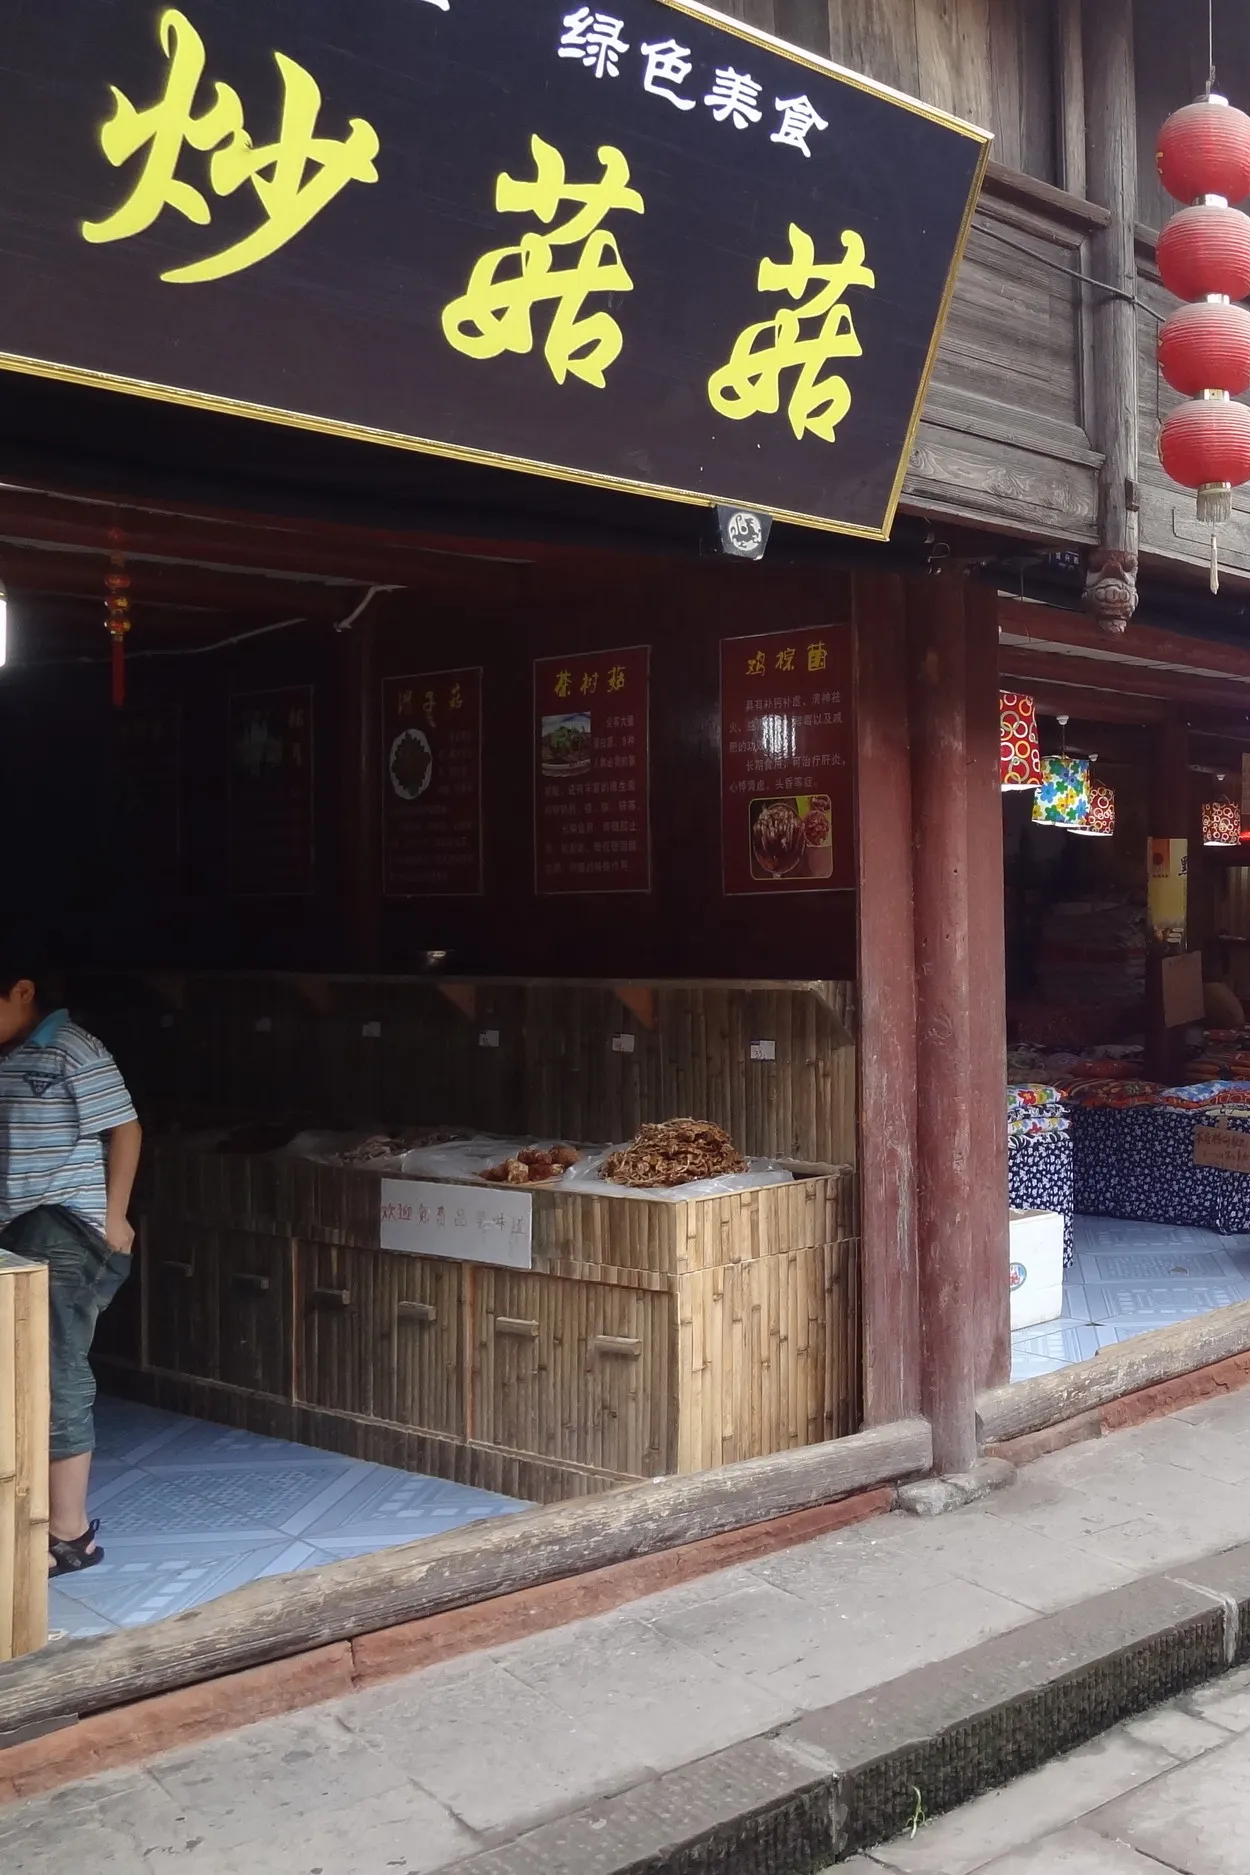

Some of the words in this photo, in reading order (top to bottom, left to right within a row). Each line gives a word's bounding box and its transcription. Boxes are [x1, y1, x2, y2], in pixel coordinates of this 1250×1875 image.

[80, 8, 876, 443] 炒菇菇
[557, 5, 829, 158] 绿色美食
